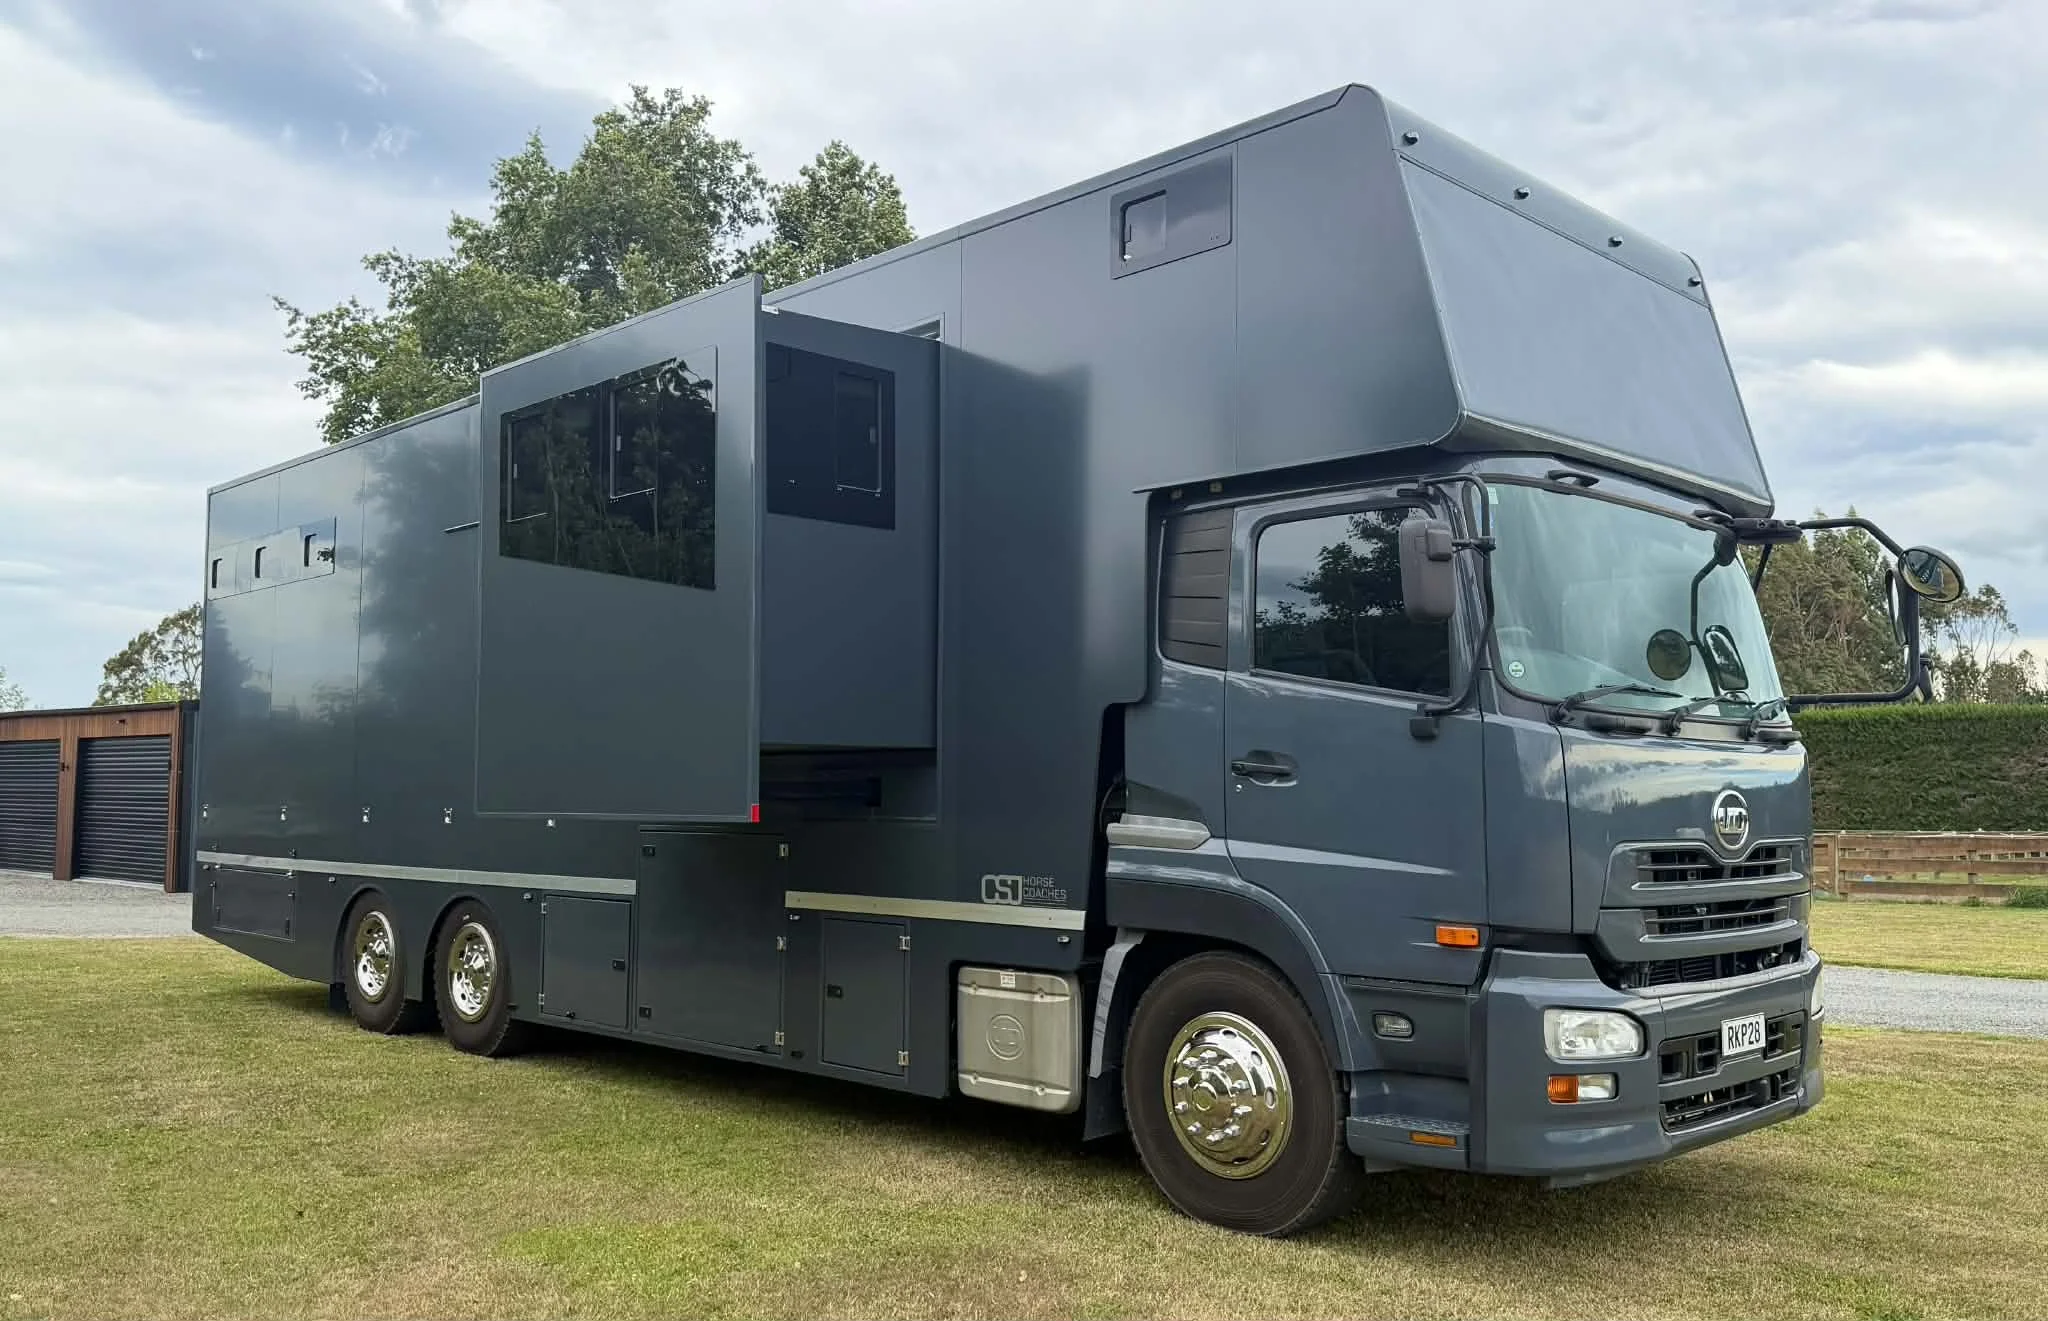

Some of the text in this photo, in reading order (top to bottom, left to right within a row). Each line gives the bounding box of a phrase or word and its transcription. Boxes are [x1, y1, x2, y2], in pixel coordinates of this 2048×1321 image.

[1023, 876, 1055, 888] HORSE
[1023, 887, 1067, 900] COACHES
[1727, 1021, 1760, 1050] RKP28
